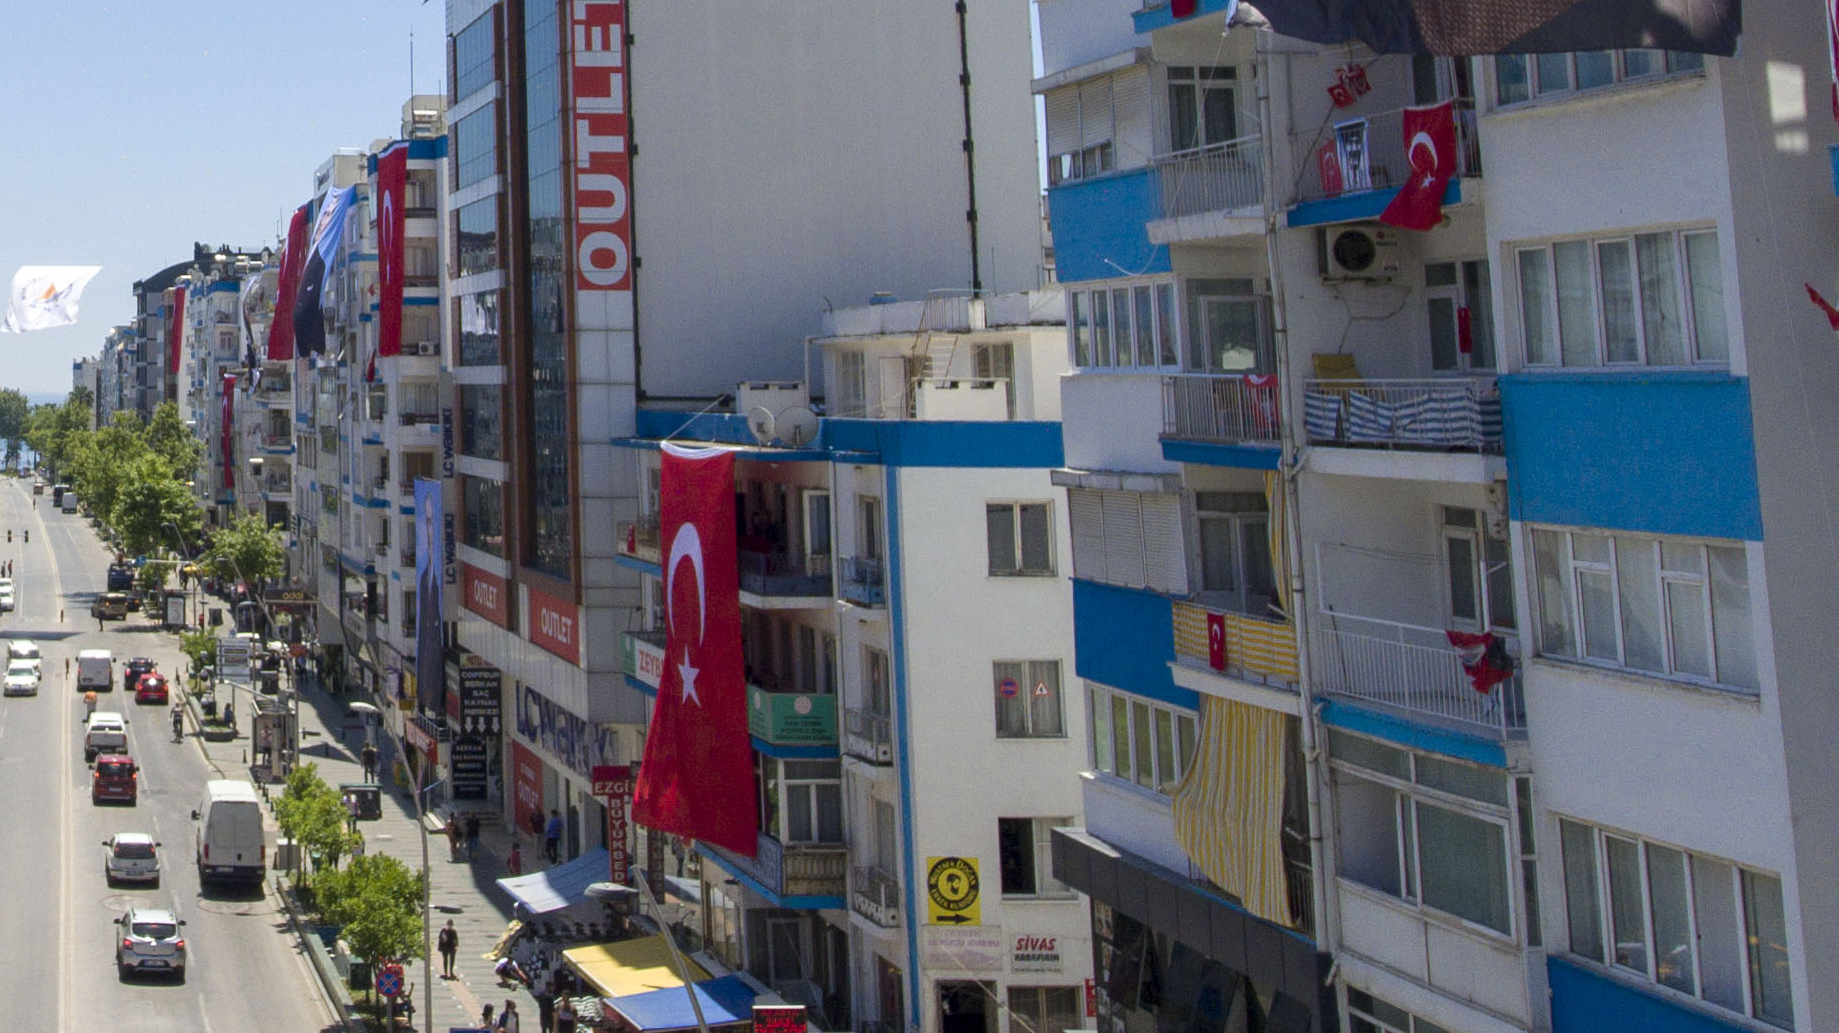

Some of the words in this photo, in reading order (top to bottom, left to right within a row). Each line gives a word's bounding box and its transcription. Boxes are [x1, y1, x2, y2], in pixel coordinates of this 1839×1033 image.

[443, 462, 454, 479] LC
[444, 566, 456, 585] LC
[474, 579, 497, 610] OUTLET
[541, 610, 573, 645] OUTLET
[639, 649, 663, 678] ZEYB
[1016, 935, 1057, 951] SİVAS
